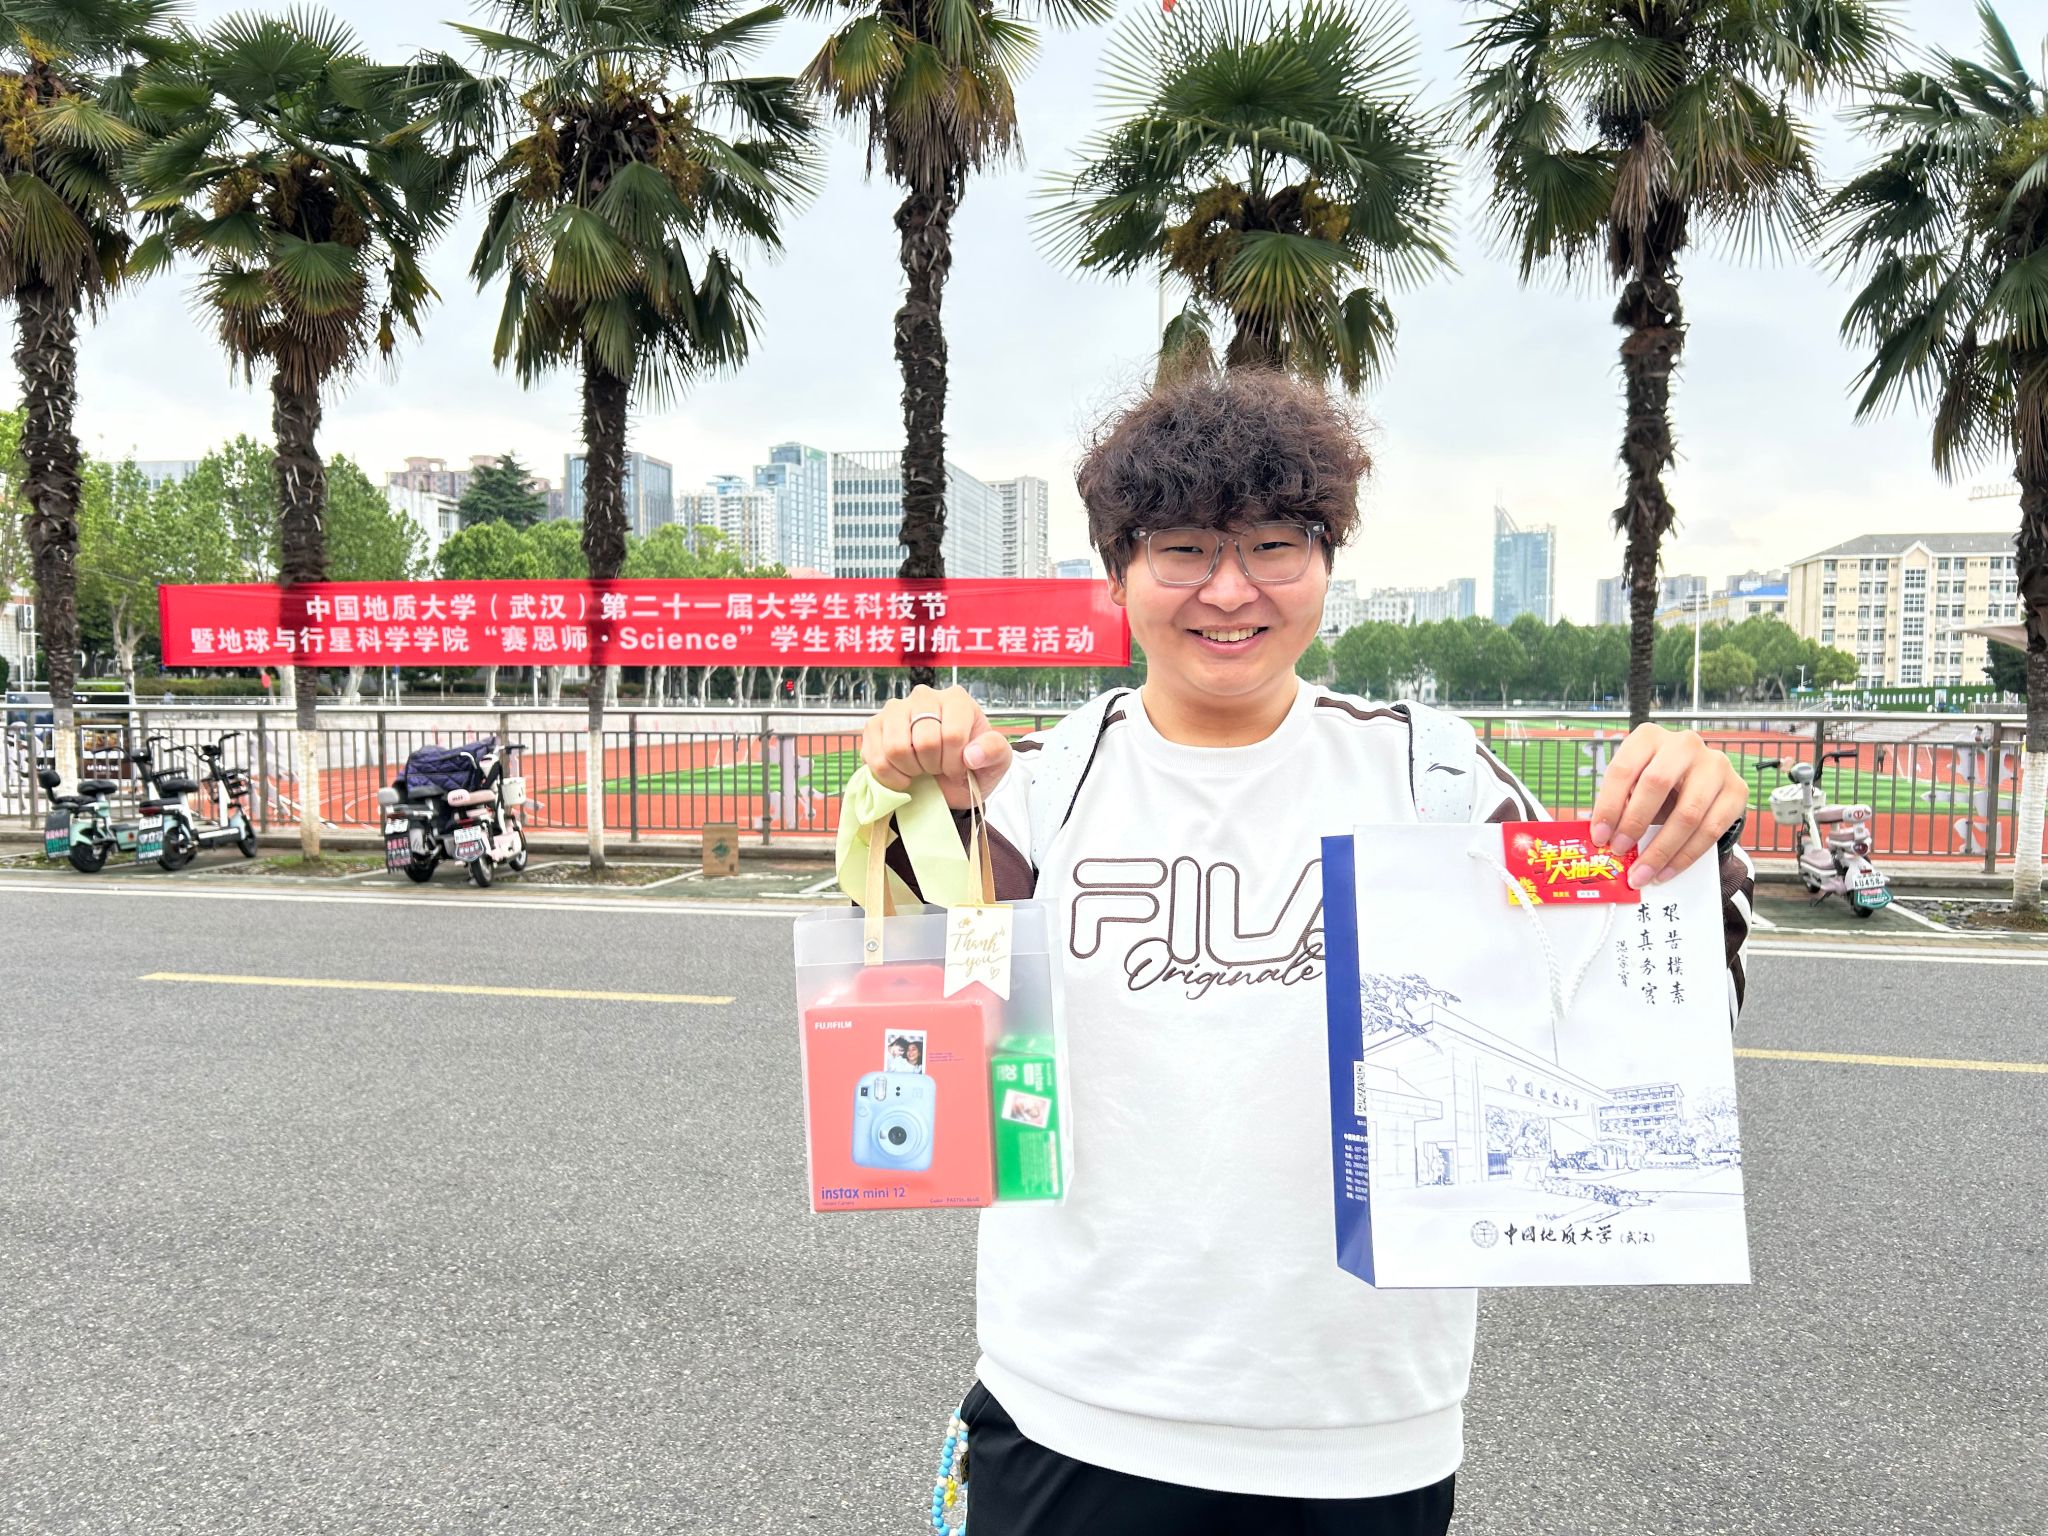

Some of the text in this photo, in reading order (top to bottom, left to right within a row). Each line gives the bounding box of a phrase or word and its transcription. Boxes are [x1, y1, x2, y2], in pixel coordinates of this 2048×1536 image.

[306, 592, 948, 623] 中国地质大学（武汉）第二十一届大学生科技节
[1532, 839, 1586, 872] 幸运
[1547, 855, 1617, 884] 大抽奖
[815, 1021, 852, 1030] FUJIFILM
[821, 1187, 905, 1200] instax mini 12
